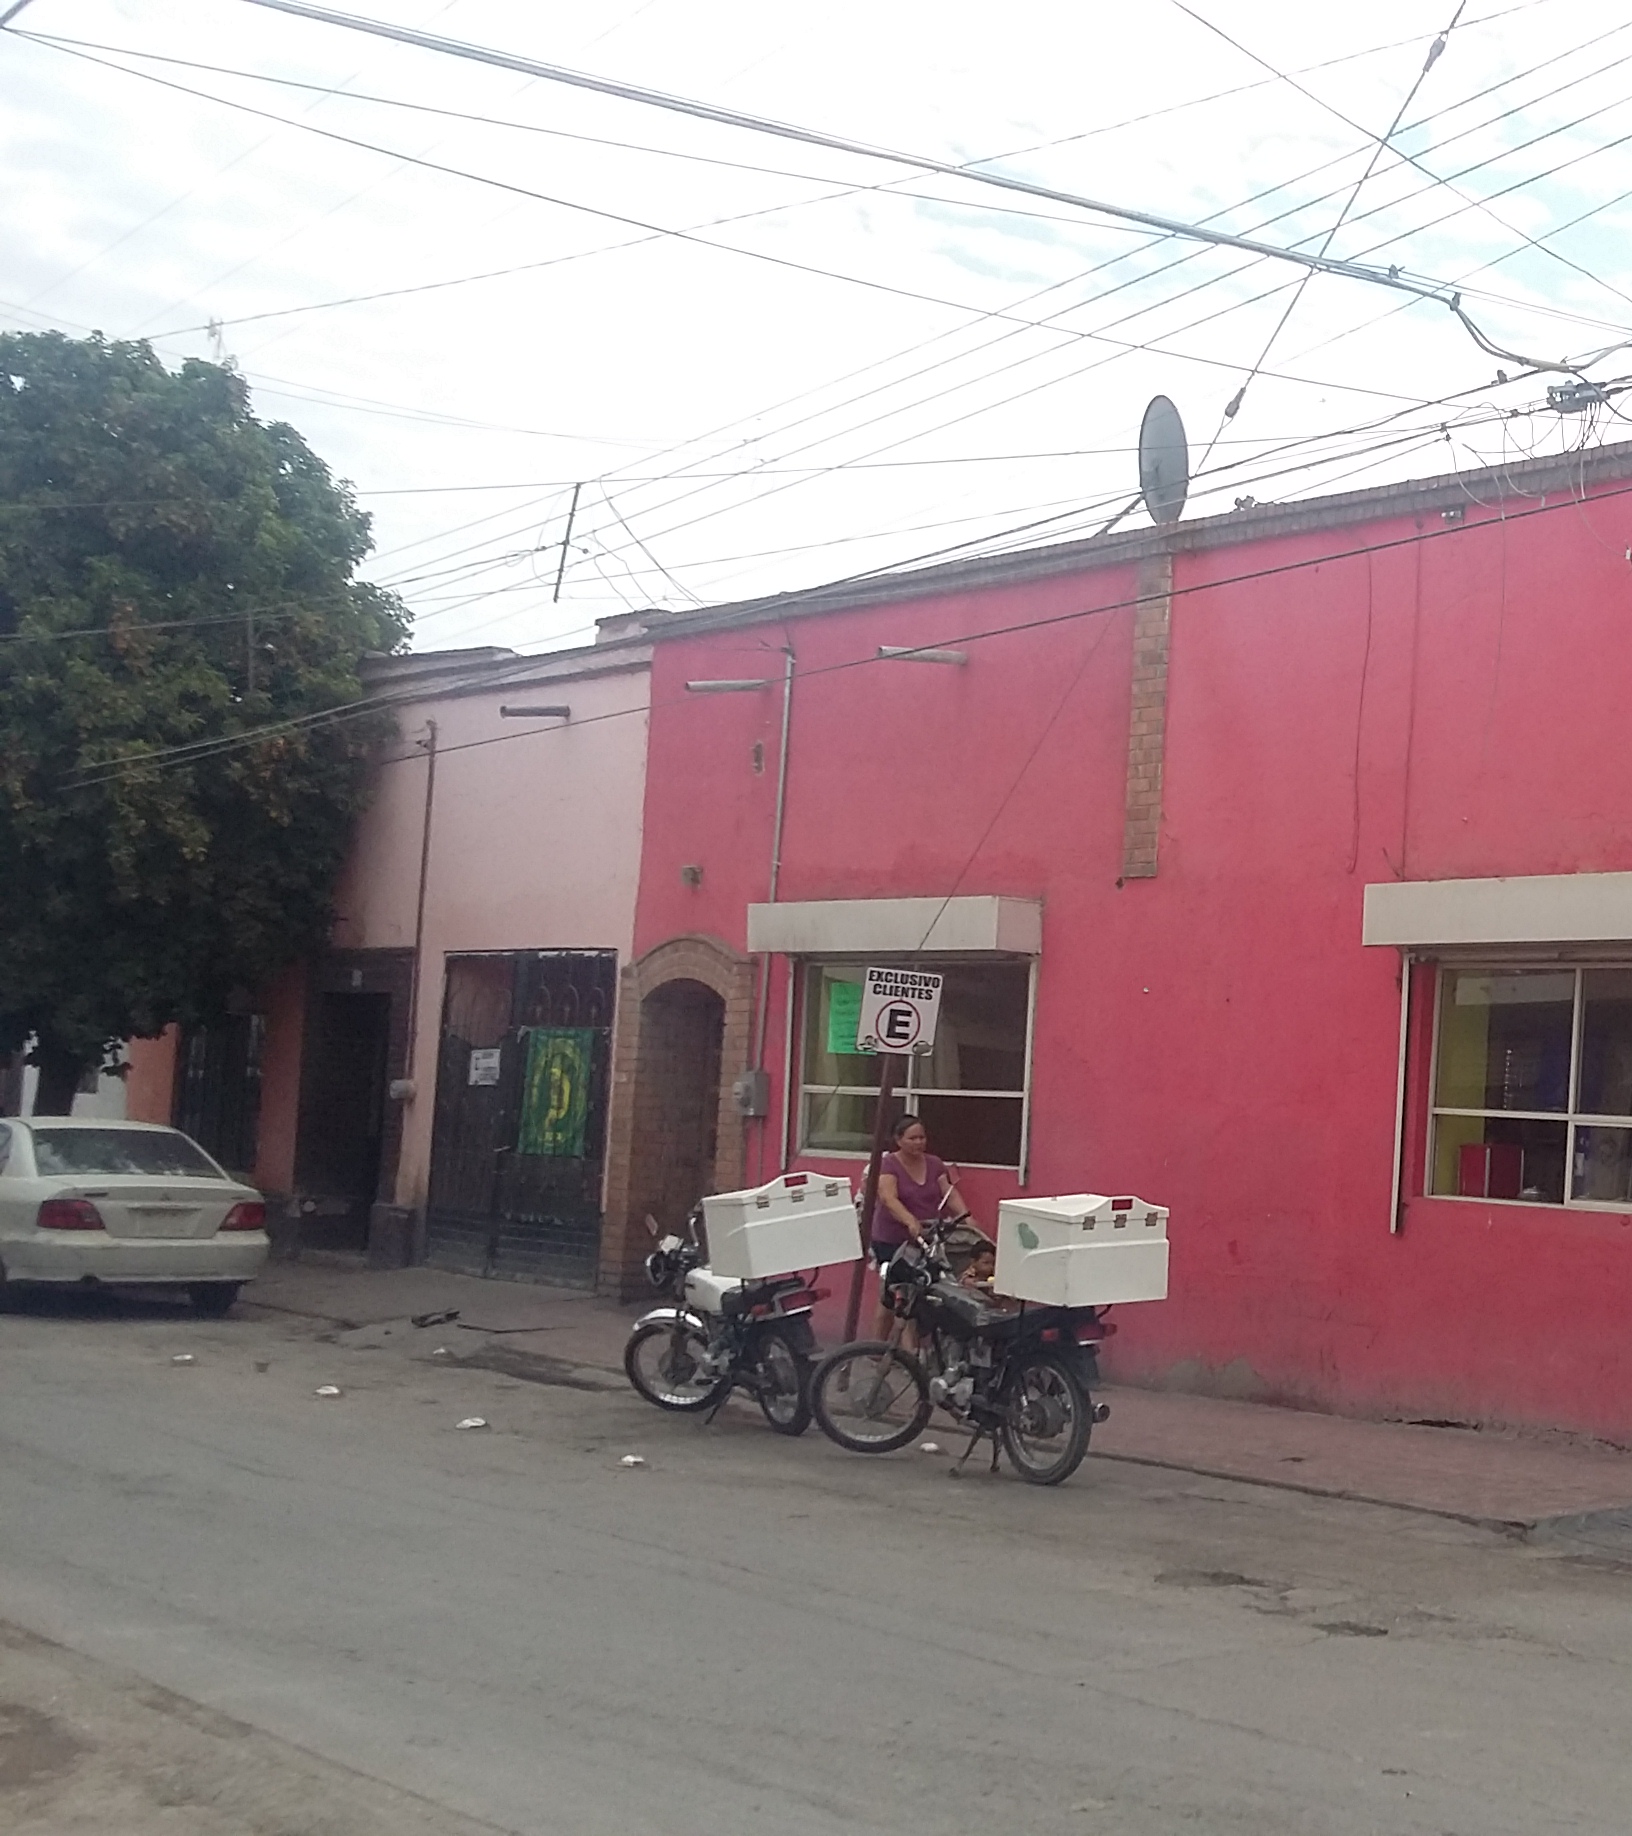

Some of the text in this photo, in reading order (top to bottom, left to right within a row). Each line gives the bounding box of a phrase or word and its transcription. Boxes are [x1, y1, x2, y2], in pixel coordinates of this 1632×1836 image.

[868, 969, 941, 988] EXCLUSIVO
[873, 983, 933, 1000] CLIENTES
[886, 1008, 912, 1039] E
